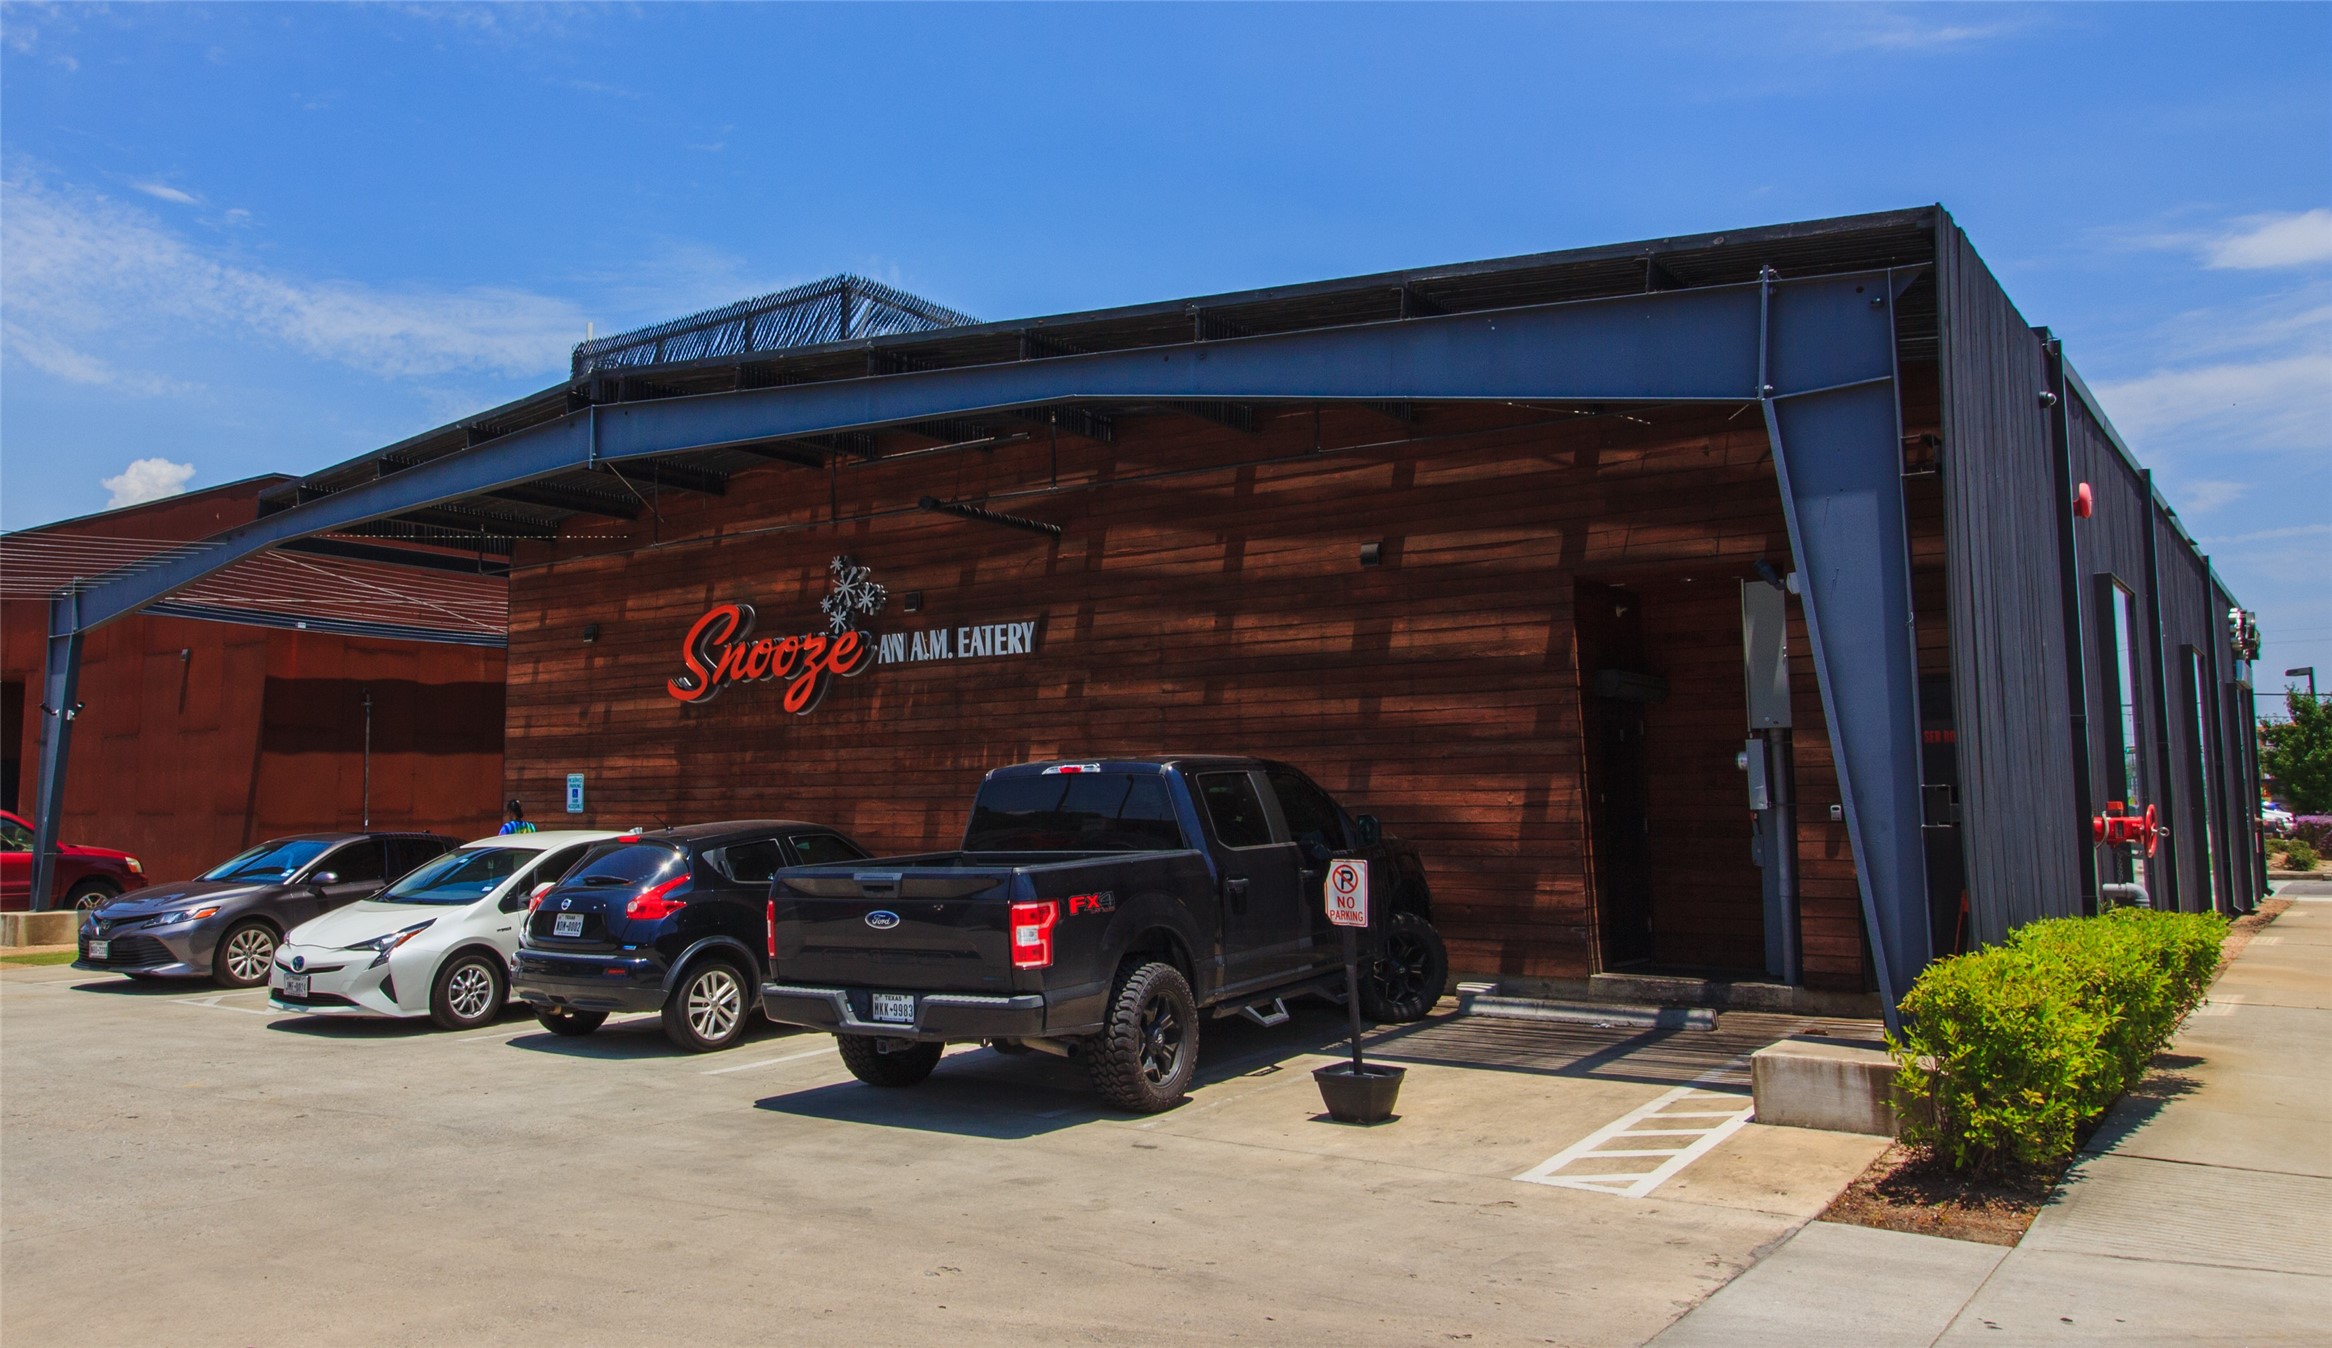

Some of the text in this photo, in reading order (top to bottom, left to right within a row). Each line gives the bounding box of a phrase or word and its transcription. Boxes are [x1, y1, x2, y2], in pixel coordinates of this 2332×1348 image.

[878, 621, 1035, 664] AN A.M. EATERY
[668, 604, 864, 714] Snooze
[1069, 891, 1115, 916] FX4
[1337, 896, 1355, 909] NO
[1330, 910, 1363, 921] PARKING
